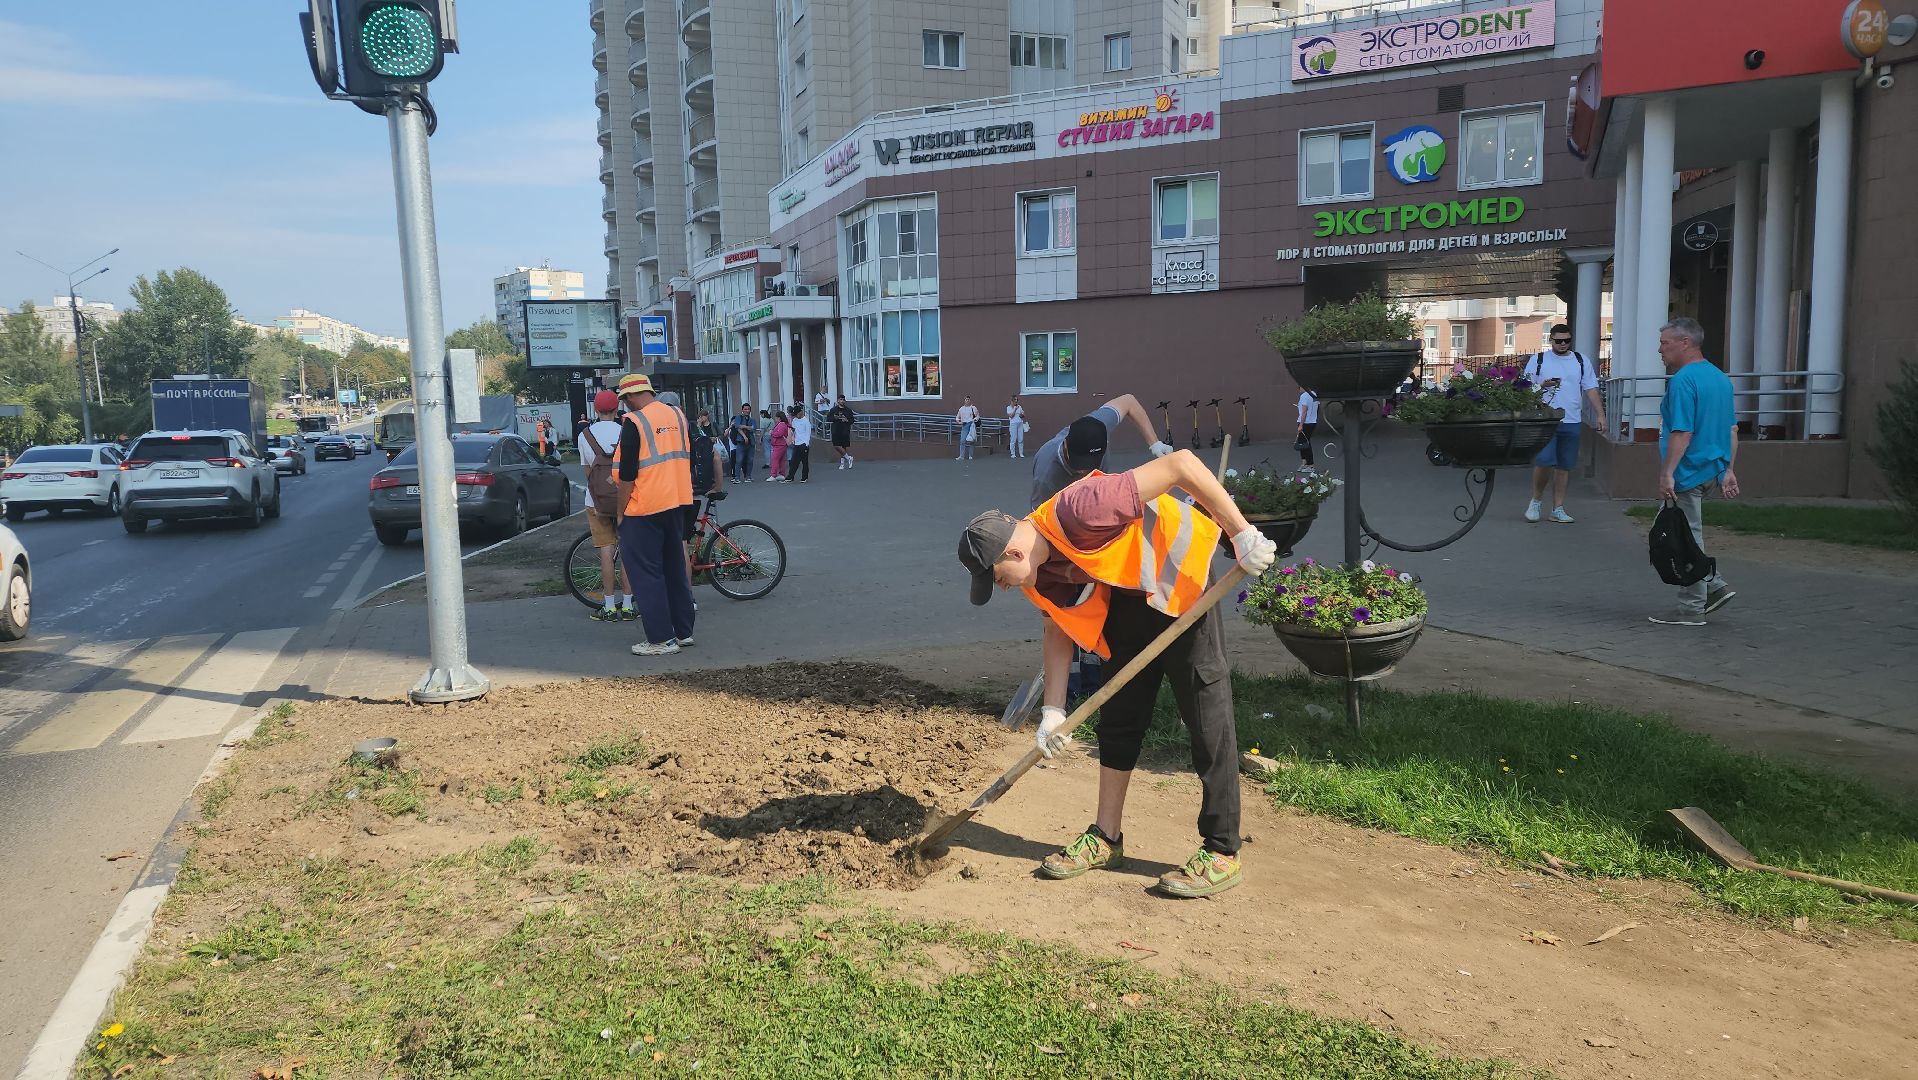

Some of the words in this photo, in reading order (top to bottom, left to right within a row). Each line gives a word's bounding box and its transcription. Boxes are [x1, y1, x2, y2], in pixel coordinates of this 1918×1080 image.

[1359, 8, 1532, 52] ЭКСТРОDENT
[1857, 9, 1883, 32] 24
[1359, 53, 1394, 68] СЕТЬ
[1398, 31, 1531, 63] СТОМАТОЛОГИЙ
[1057, 121, 1136, 148] СТУДИЯ
[1140, 111, 1215, 138] ЗАГАРА
[1079, 105, 1148, 126] ВИТАМИН
[909, 129, 966, 151] VISION
[974, 121, 1034, 144] REPAIR
[909, 151, 942, 164] РЕМОНТ
[943, 145, 997, 161] МОБИЛЬНОЙ
[998, 141, 1036, 155] ТЕХНИКИ
[1313, 196, 1525, 237] ЭКСТРОMED
[1276, 248, 1300, 261] ЛОР
[1302, 247, 1311, 259] И
[1313, 240, 1405, 258] СТОМАТОЛОГИЯ
[1408, 239, 1435, 254] ДЛЯ
[1438, 233, 1478, 251] ДЕТЕЙ
[1481, 234, 1490, 246] И
[1493, 228, 1567, 246] ВЗРОСЛЫХ
[1165, 259, 1203, 271] Класс
[166, 389, 201, 399] ПОЧТА
[202, 389, 237, 398] РОССИИ
